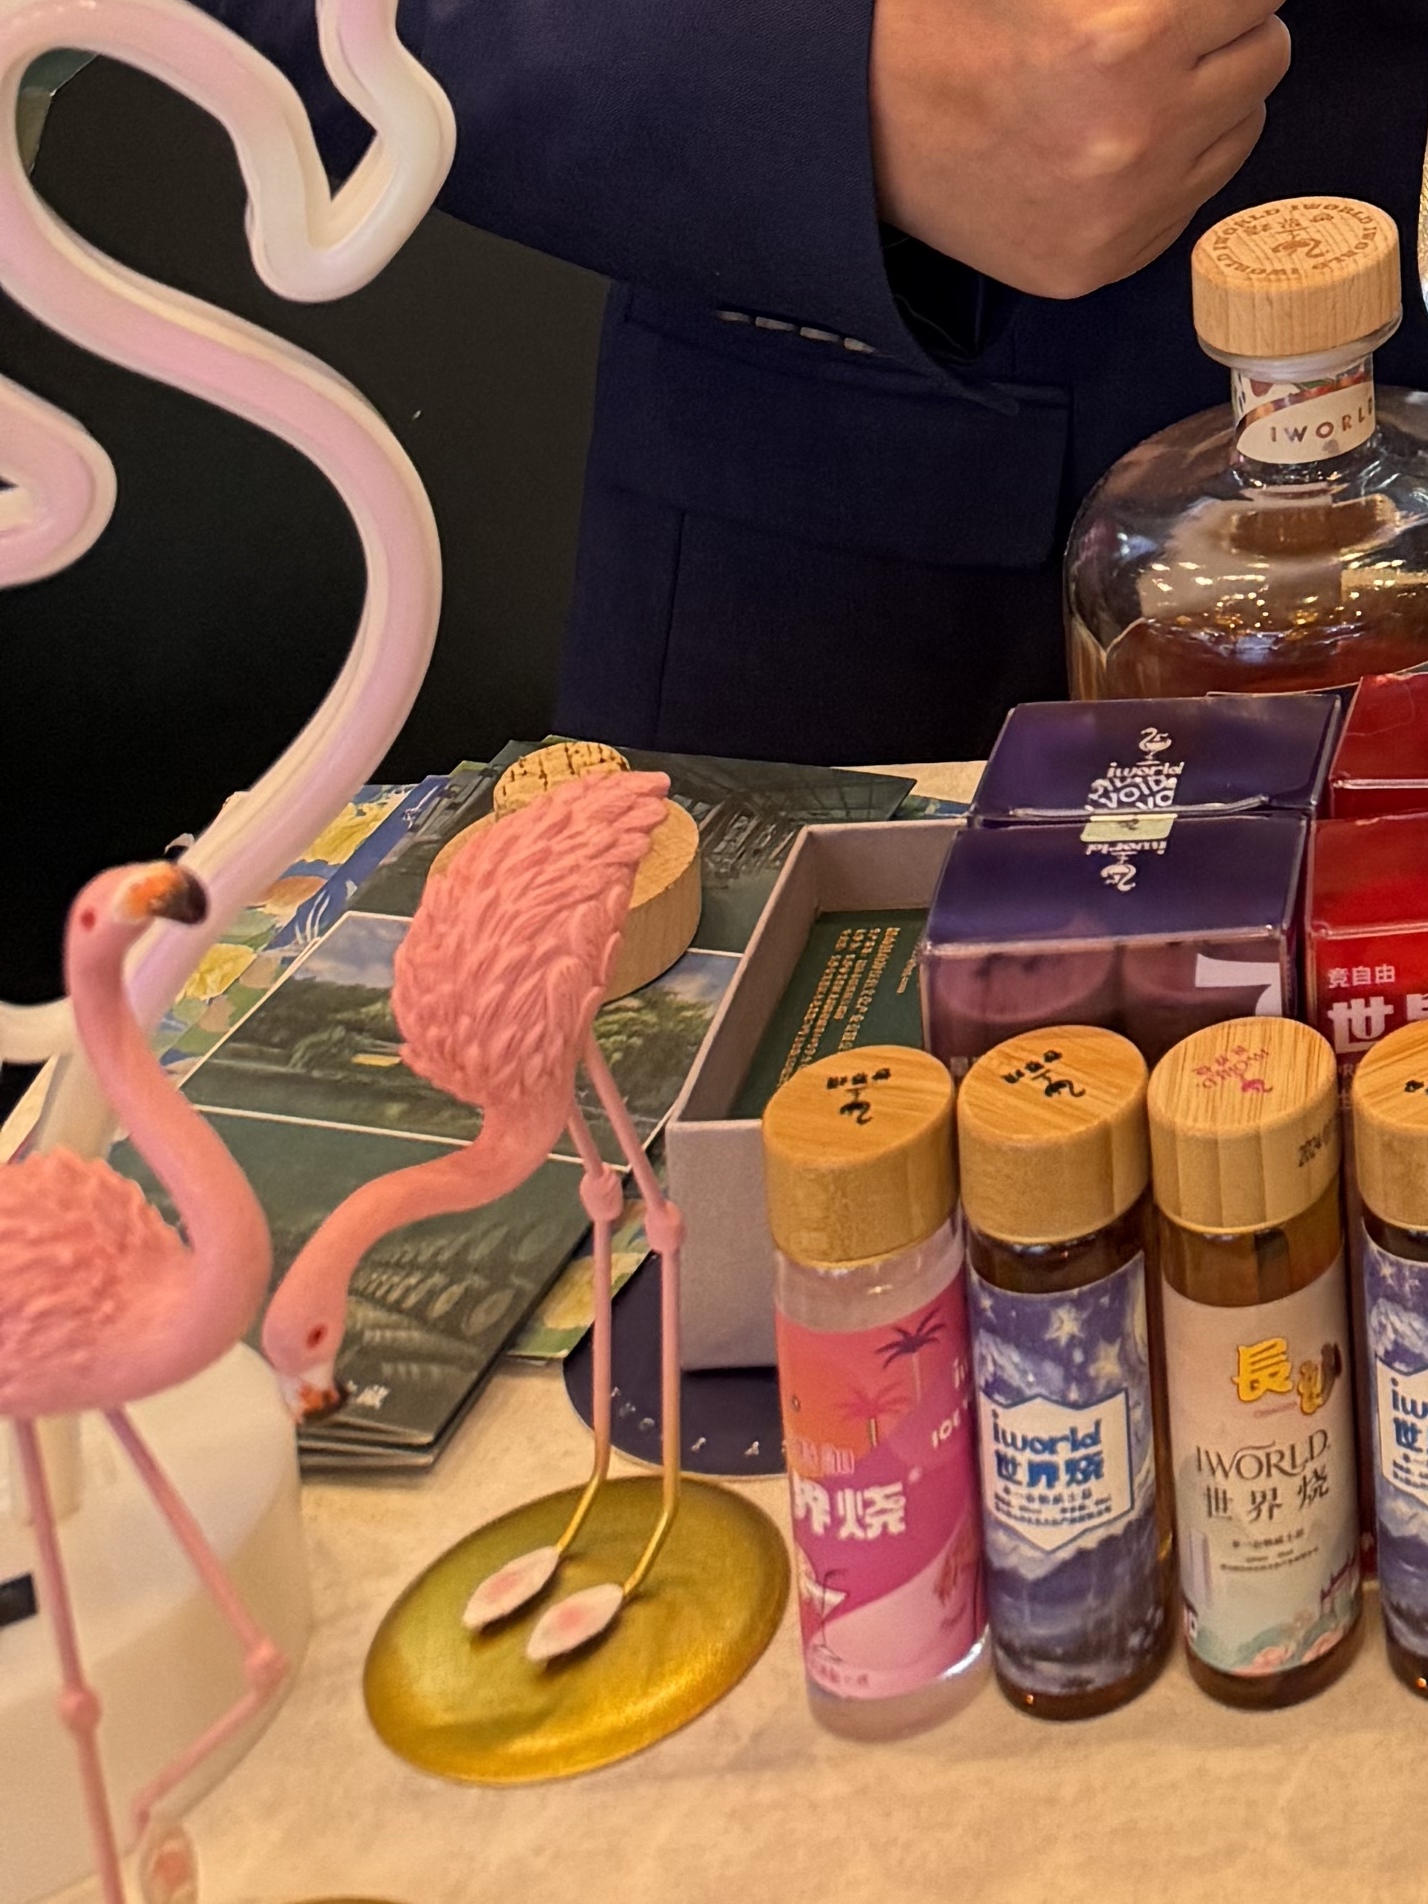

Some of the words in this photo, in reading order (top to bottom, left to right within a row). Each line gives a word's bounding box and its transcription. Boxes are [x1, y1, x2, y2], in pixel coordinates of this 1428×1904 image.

[1106, 761, 1185, 778] iworld
[991, 1408, 1103, 1455] iworld
[1195, 1428, 1330, 1482] IWORLD
[1202, 1464, 1331, 1523] 世界烧
